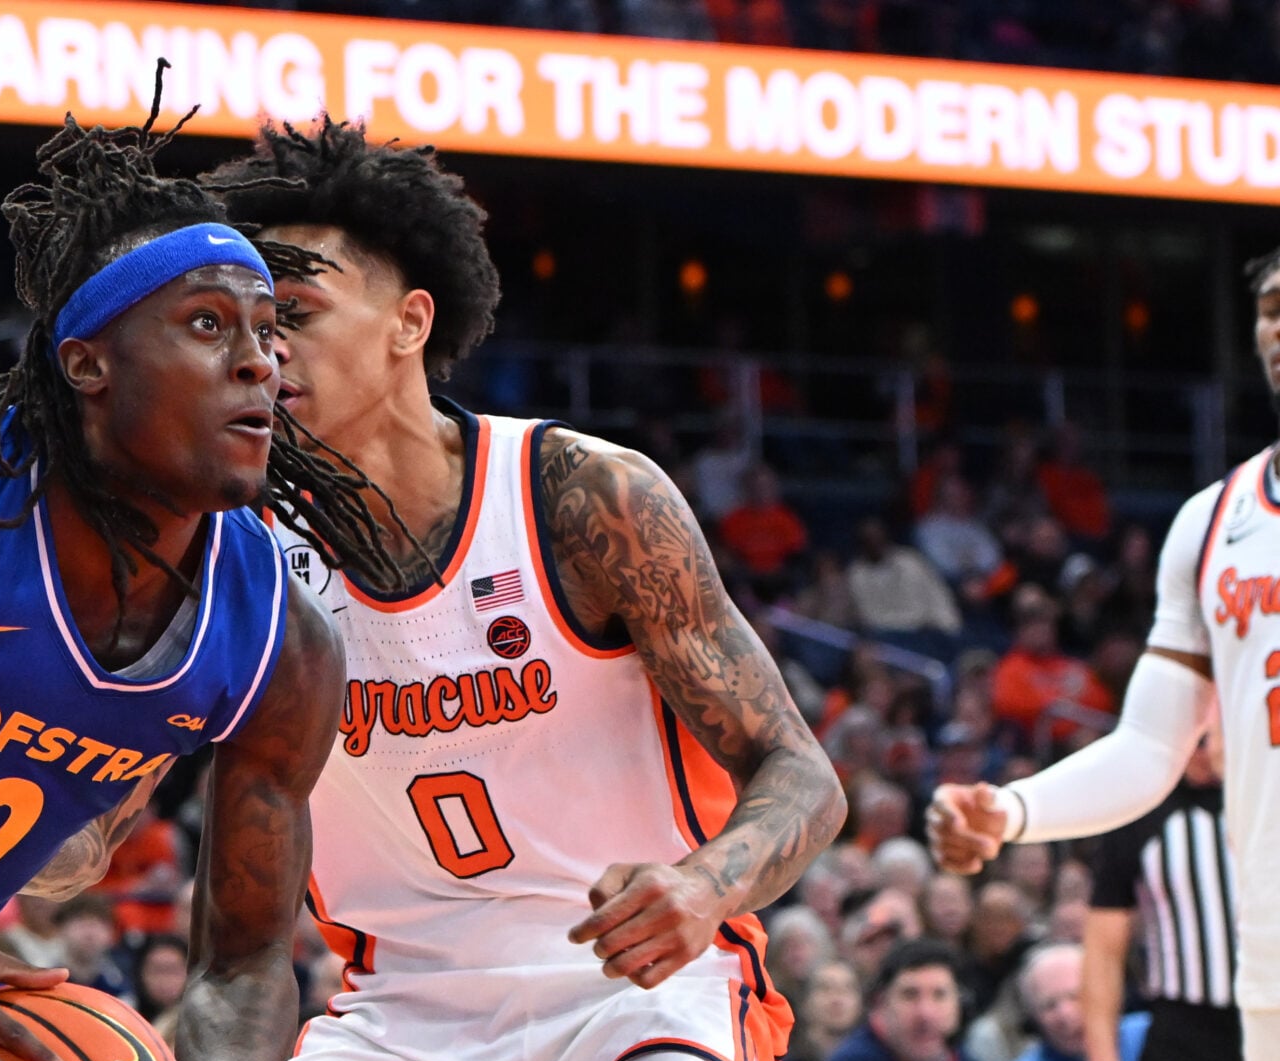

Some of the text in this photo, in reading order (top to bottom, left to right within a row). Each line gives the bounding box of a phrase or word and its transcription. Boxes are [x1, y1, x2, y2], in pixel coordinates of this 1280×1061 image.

[344, 39, 525, 137] FOR
[538, 53, 711, 148] THE
[725, 66, 1080, 174] MODERN
[1093, 93, 1280, 189] STUD
[291, 551, 310, 570] LM
[496, 629, 525, 641] ACC
[338, 658, 558, 758] yracuse
[406, 770, 516, 880] 0
